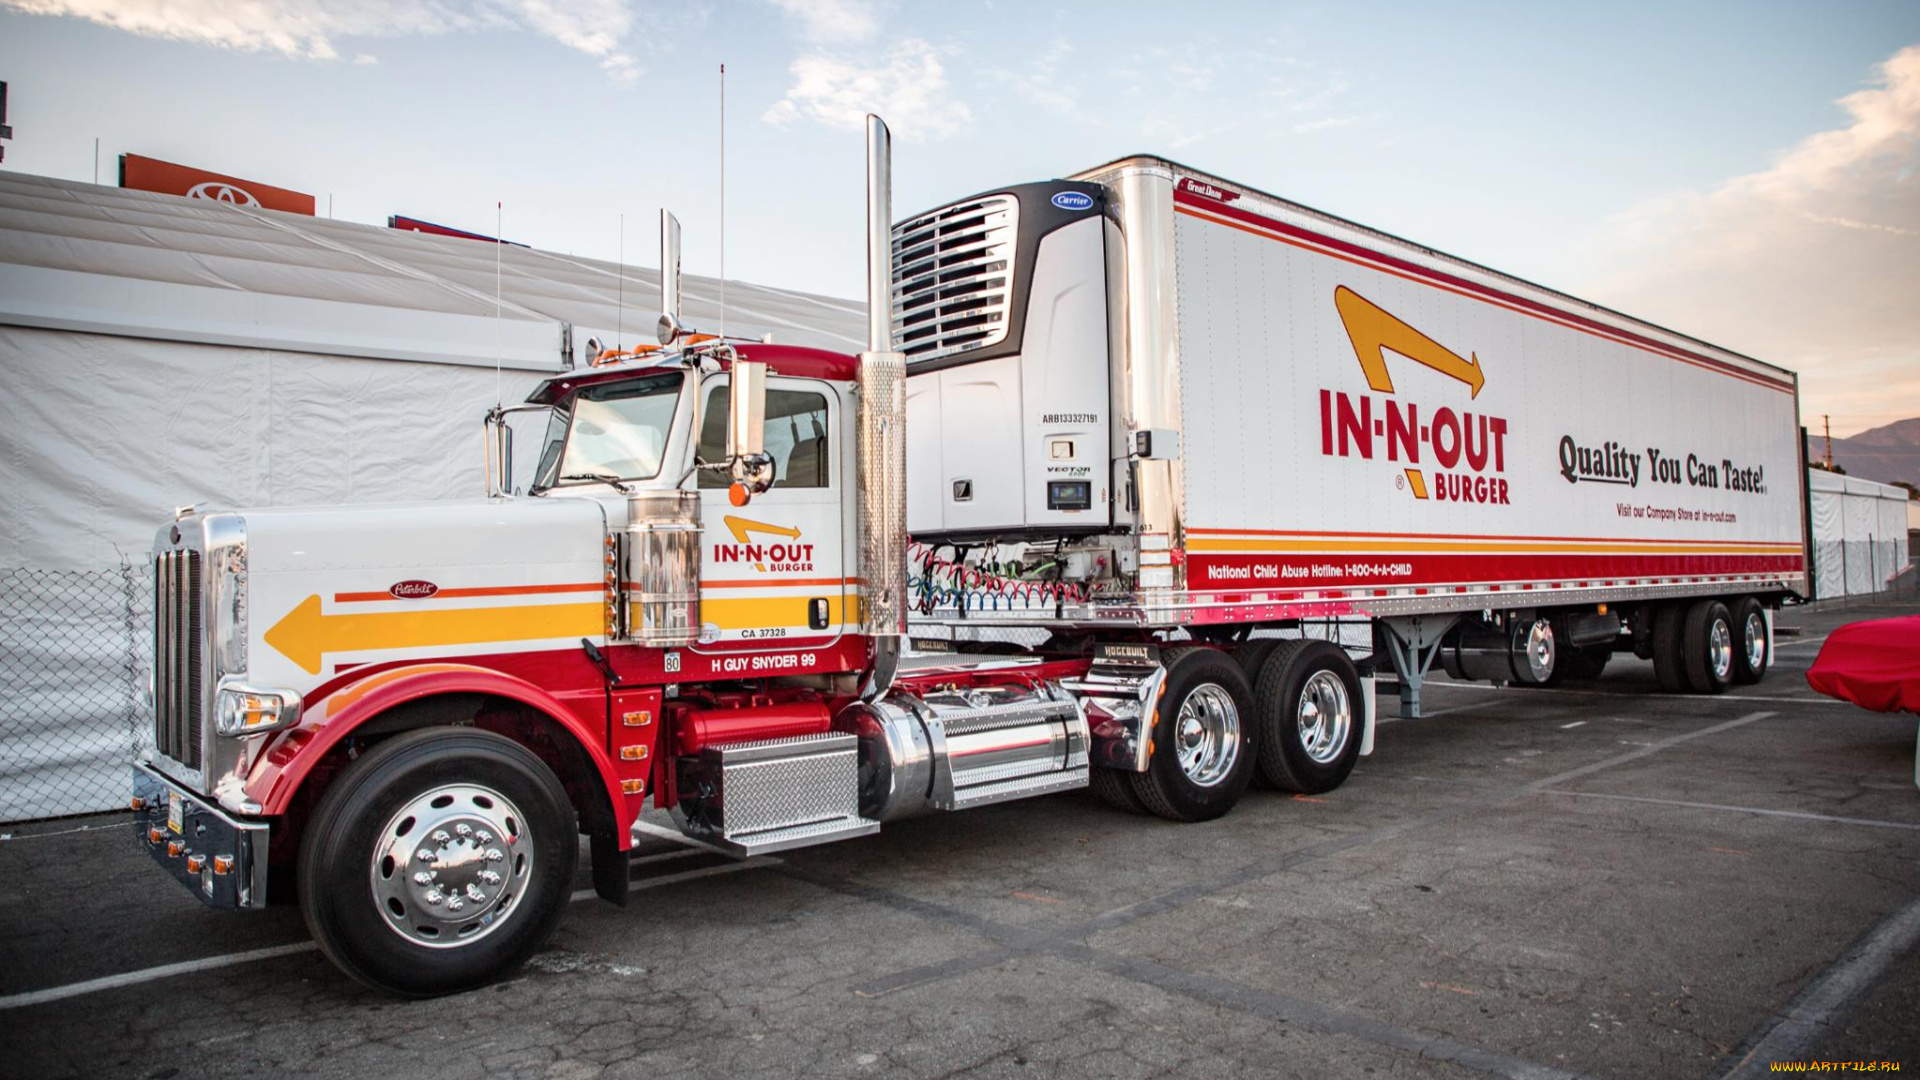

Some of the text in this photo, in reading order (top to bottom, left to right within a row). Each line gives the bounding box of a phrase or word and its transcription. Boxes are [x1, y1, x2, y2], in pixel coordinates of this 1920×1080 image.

[1057, 195, 1088, 205] Carrier
[1320, 389, 1507, 472] IN-N-OUT
[1559, 434, 1765, 495] Quality You Can Taste!
[1435, 472, 1511, 505] BURGER
[1616, 503, 1737, 523] Visit our Company Store at in-n-out.com
[714, 544, 813, 562] IN-N-OUT
[770, 563, 813, 572] BURGER
[1208, 563, 1412, 579] National Child Abuse Hotline: 1-800-4-A-CHILD
[395, 583, 433, 595] Peterbilt
[741, 628, 786, 639] CA 37328
[666, 657, 679, 671] 80
[711, 653, 816, 672] H GUY SNYDER 99
